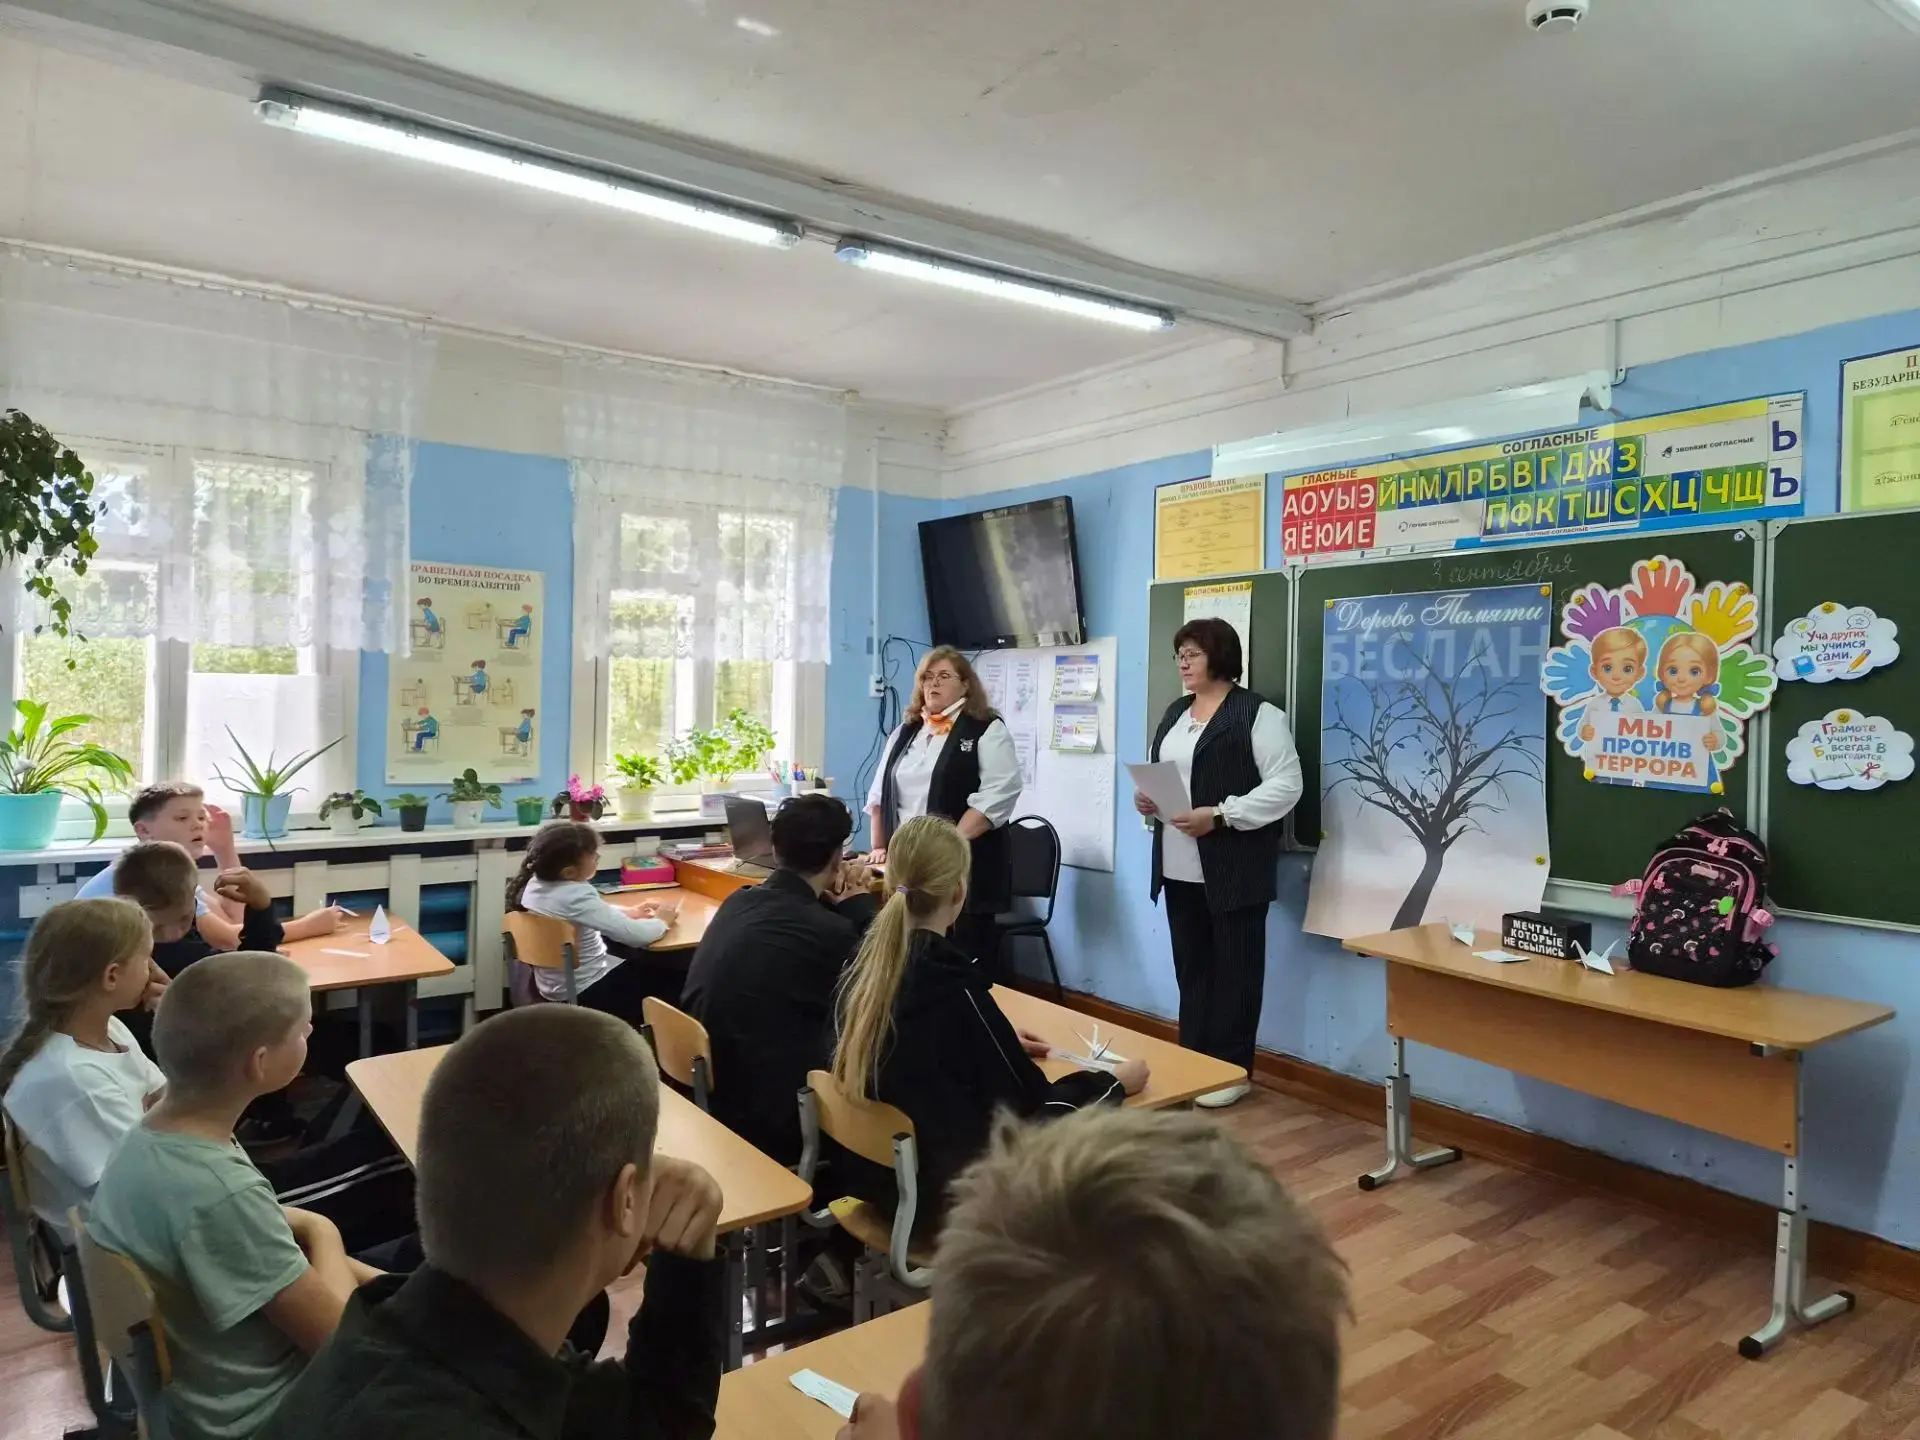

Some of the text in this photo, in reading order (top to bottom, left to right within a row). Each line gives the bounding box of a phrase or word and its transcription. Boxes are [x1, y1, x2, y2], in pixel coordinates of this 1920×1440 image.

[1502, 428, 1600, 455] СОГЛАСНЫЕ
[1675, 437, 1755, 453] ЗВОНКИЕ СОГЛАСНЫЕ
[1772, 420, 1798, 452] Ь
[1301, 468, 1358, 486] ГЛАСНЫЕ
[418, 575, 521, 592] ВО ВРЕМЯ ЗАНЯТИЙ
[483, 571, 532, 583] ПОСАДКА
[1336, 593, 1544, 639] Дерево Памяти
[1807, 630, 1828, 642] Уча
[1325, 622, 1549, 681] БЕСЛАН
[1800, 640, 1866, 653] мы учимся
[1815, 650, 1854, 662] сами.
[1617, 717, 1673, 739] МЫ
[1821, 722, 1877, 736] Грамоте
[1602, 737, 1693, 759] ПРОТИВ
[1831, 742, 1871, 752] всегда
[1595, 754, 1698, 779] ТЕРРОРА
[1503, 936, 1565, 958] НЕ СБЫЛИСЬ
[1510, 928, 1564, 948] КОТОРЫЕ
